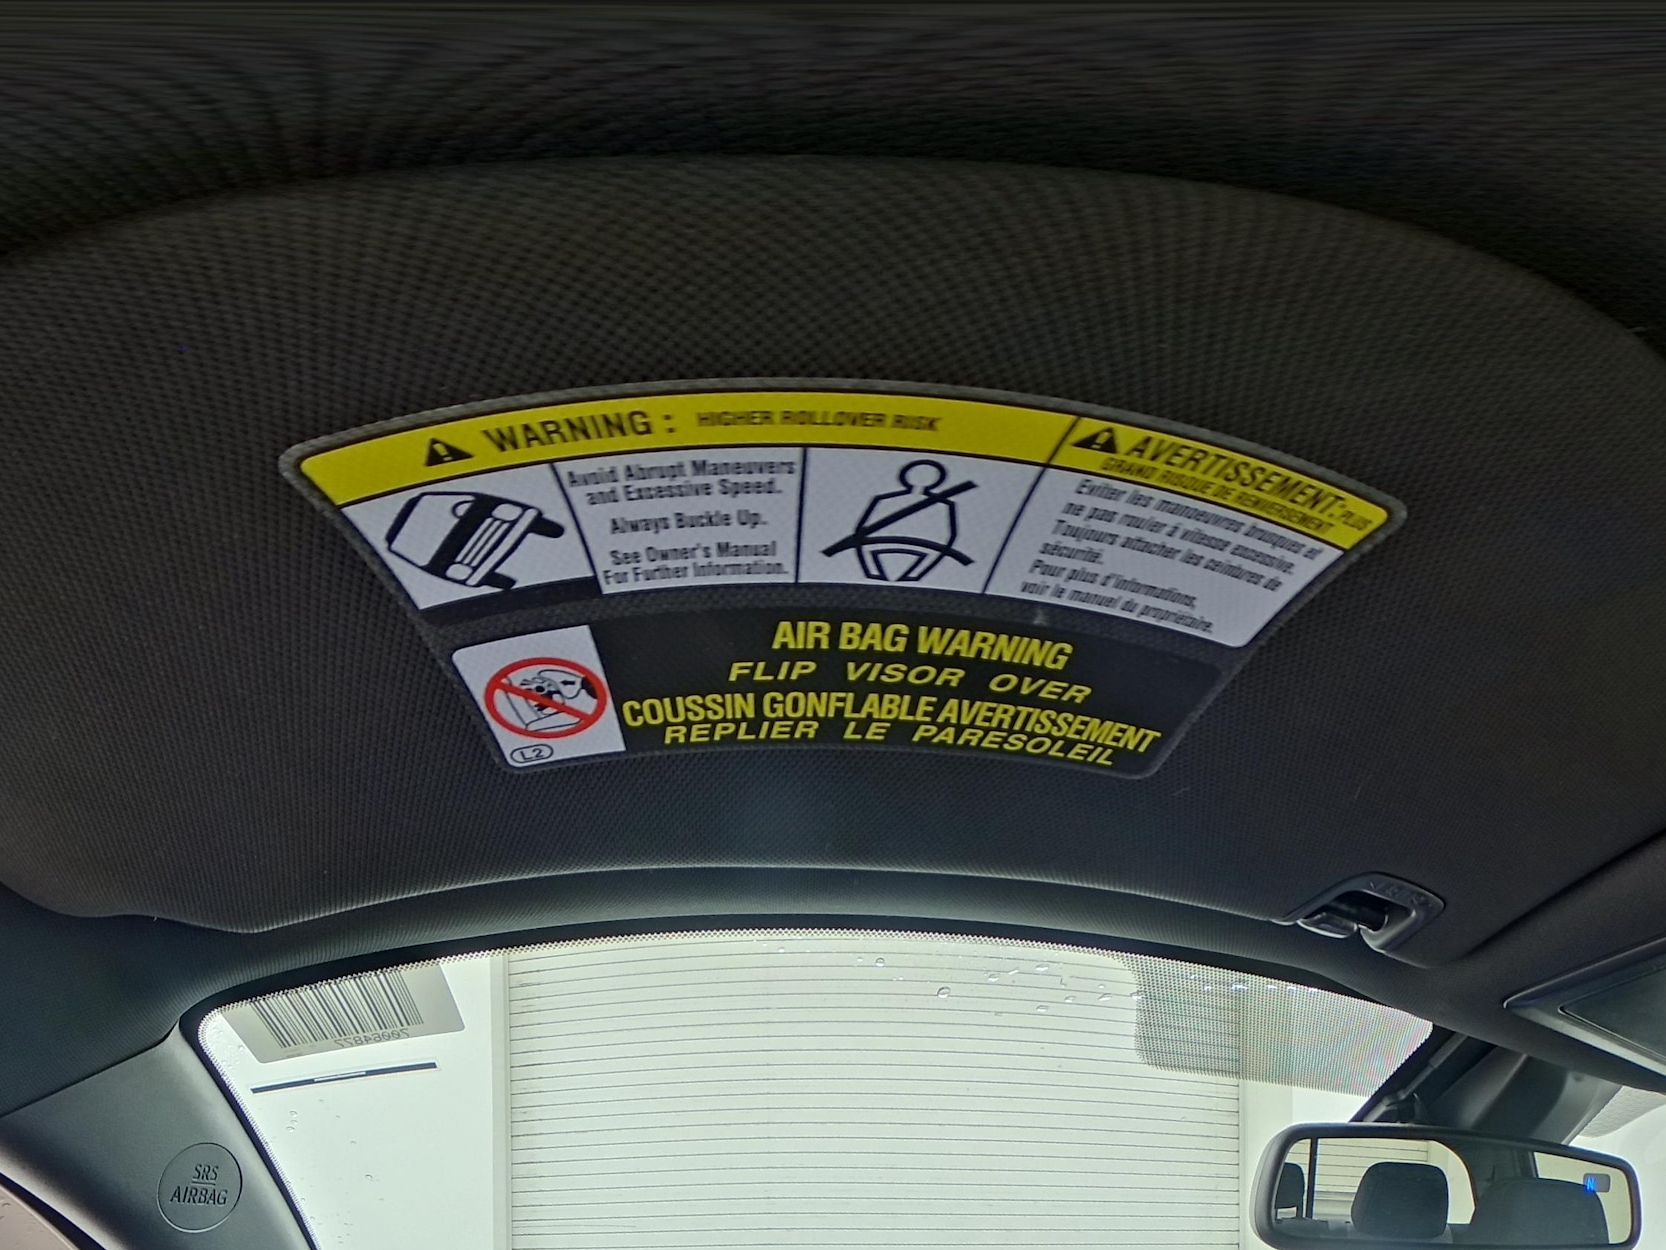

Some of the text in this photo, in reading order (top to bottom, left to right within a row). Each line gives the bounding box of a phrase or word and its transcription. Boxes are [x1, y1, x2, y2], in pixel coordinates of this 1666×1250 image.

[483, 410, 653, 452] WARNING
[697, 410, 942, 432] HIGHER ROLLOVER RISK
[567, 460, 796, 487] Avoid Abrupt Maneuvers
[586, 478, 783, 505] and Excessive Speed.
[1125, 489, 1155, 509] les
[610, 509, 768, 535] Always Buckle Up.
[1061, 502, 1086, 516] ne
[1084, 506, 1119, 524] pas
[1118, 512, 1167, 535] rouler
[1179, 528, 1232, 552] vitesse
[610, 541, 777, 566] See Owner's Manual
[1051, 519, 1121, 546] Toujours
[1118, 534, 1183, 560] attacher
[1180, 550, 1205, 567] les
[1202, 557, 1266, 587] ceintures
[603, 560, 789, 585] For Further Information.
[1029, 559, 1068, 578] Pour
[1063, 567, 1100, 587] plus
[1020, 581, 1051, 596] voir
[1052, 585, 1067, 599] le
[1068, 588, 1120, 612] manuel
[771, 620, 1073, 670] AIR BAG WARNING
[728, 661, 1092, 703] FLIP VISOR OVER
[622, 691, 1162, 753] COUSSIN GONFLABLE AVERTISSEMENT
[520, 748, 544, 760] L2
[664, 720, 1114, 766] REPLIER LE PARESOLEIL
[192, 1163, 219, 1181] SRS
[169, 1186, 228, 1206] AIRBAG
